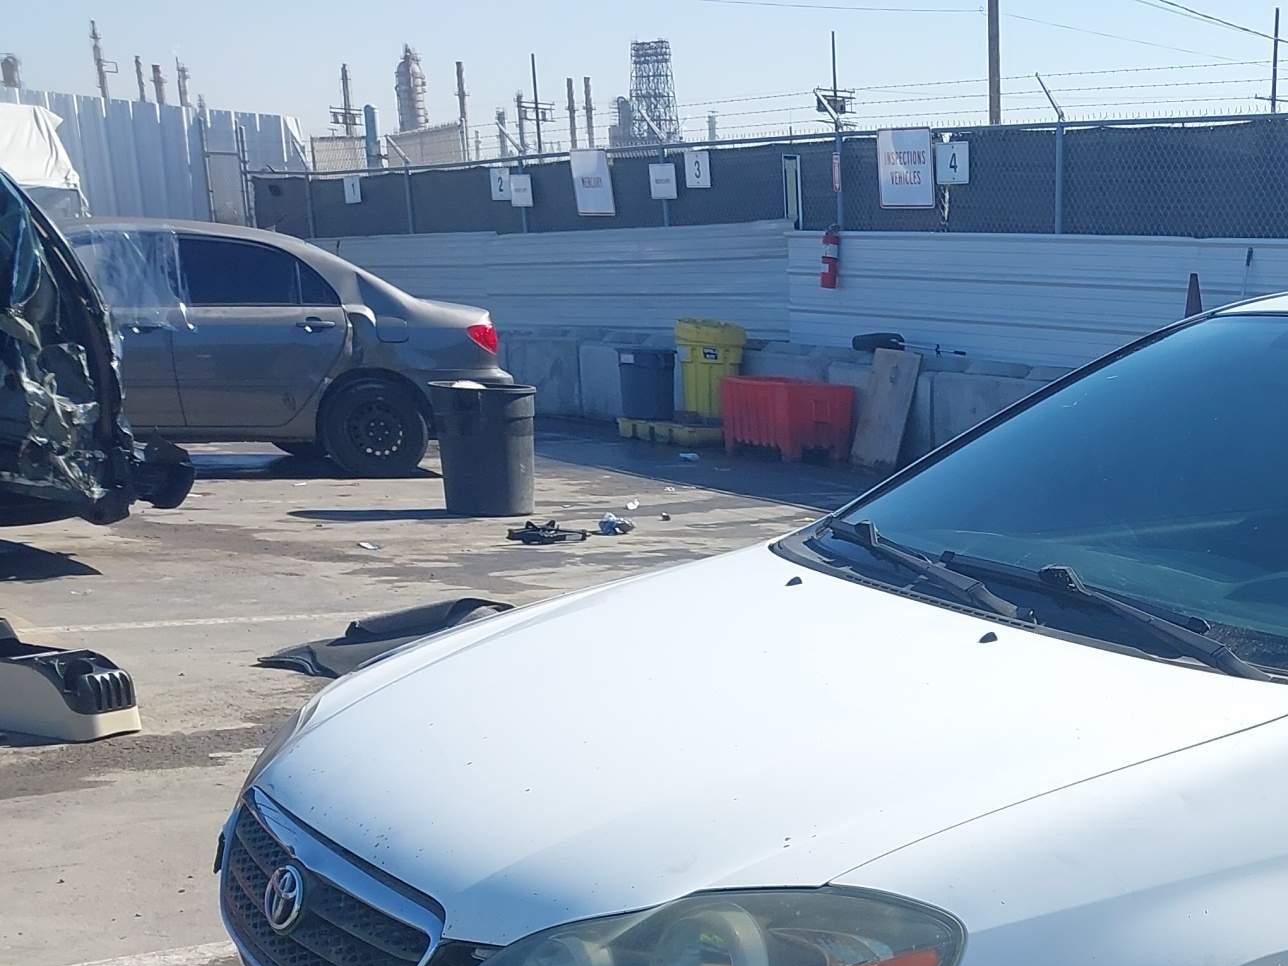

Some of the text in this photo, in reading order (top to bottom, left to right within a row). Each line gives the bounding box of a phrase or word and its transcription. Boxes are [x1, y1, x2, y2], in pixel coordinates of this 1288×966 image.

[883, 150, 926, 166] INSPECTIONS
[949, 152, 958, 174] 4
[694, 160, 701, 179] 3
[890, 170, 922, 186] VEHICLES
[497, 176, 504, 193] 2
